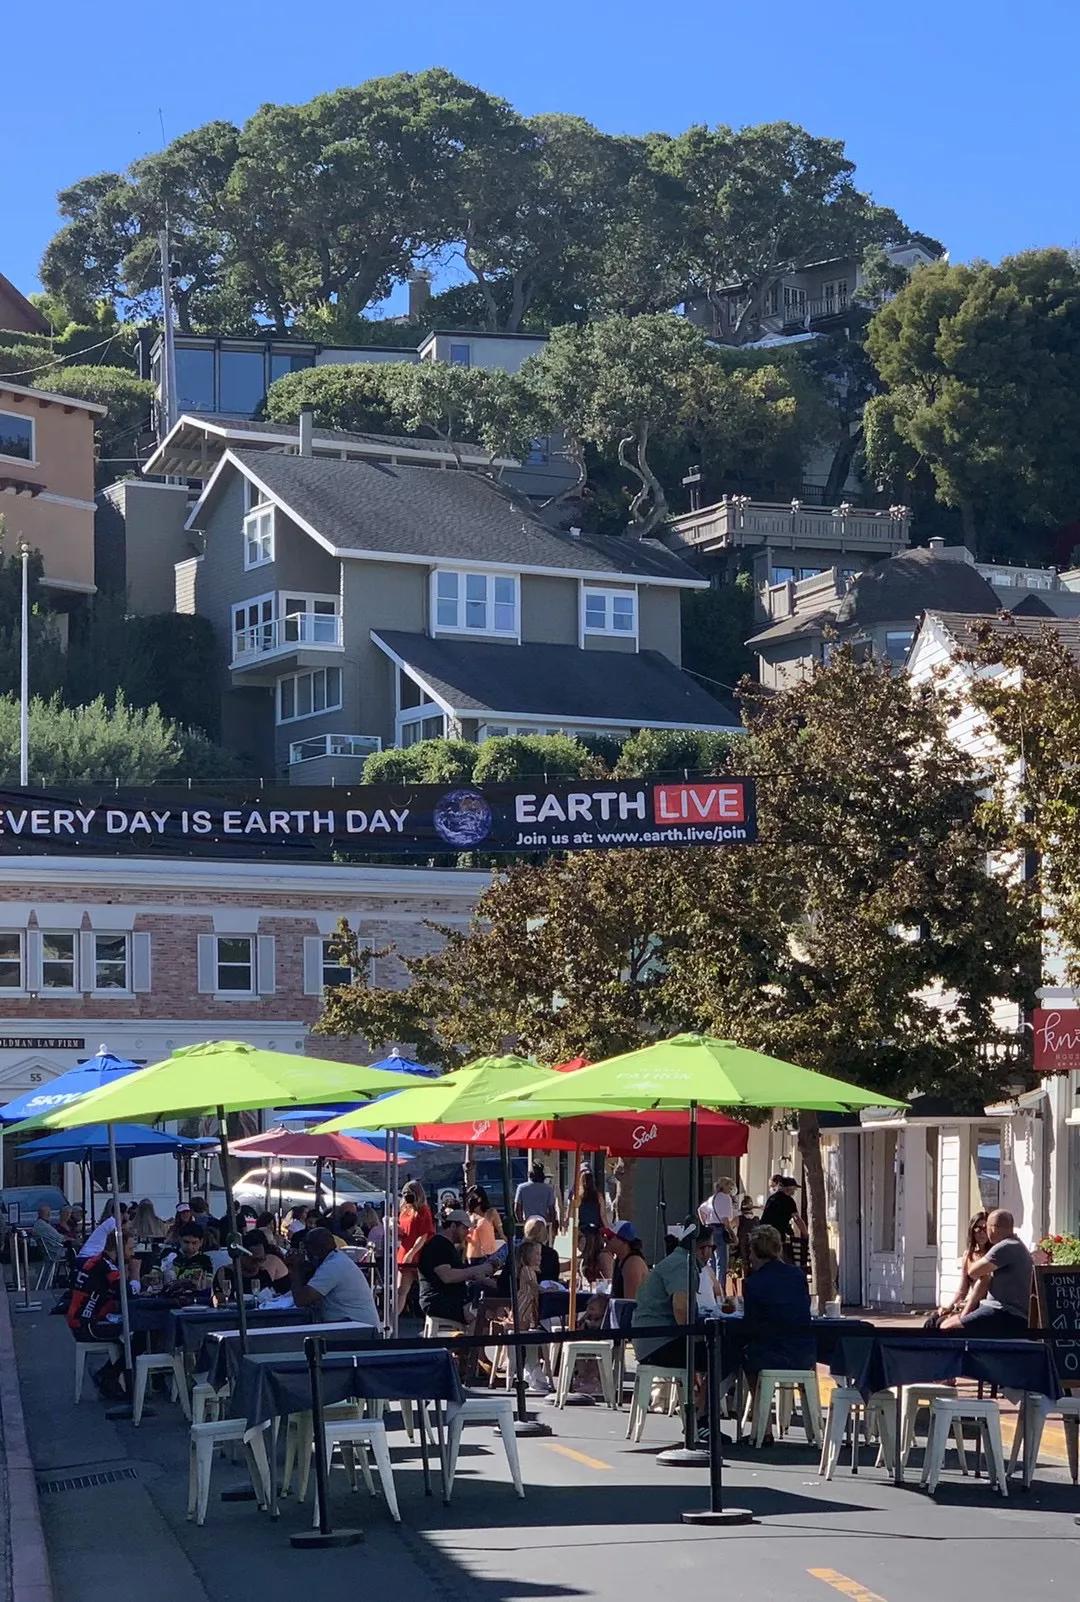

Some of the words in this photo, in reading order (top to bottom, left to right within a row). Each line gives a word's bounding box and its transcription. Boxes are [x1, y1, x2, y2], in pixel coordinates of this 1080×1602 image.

[514, 791, 645, 823] EARTH
[659, 788, 739, 819] LIVE
[106, 810, 171, 834] DAY
[182, 810, 212, 833] IS
[223, 810, 335, 834] EARTH
[346, 808, 410, 833] DAY
[516, 832, 547, 846] Join
[551, 833, 569, 845] us
[573, 832, 593, 844] at:
[597, 826, 747, 843] www.earth.live/join
[37, 1039, 55, 1048] LAW
[58, 1039, 79, 1048] FIRM
[30, 1073, 42, 1082] 55
[82, 1291, 100, 1318] BMC
